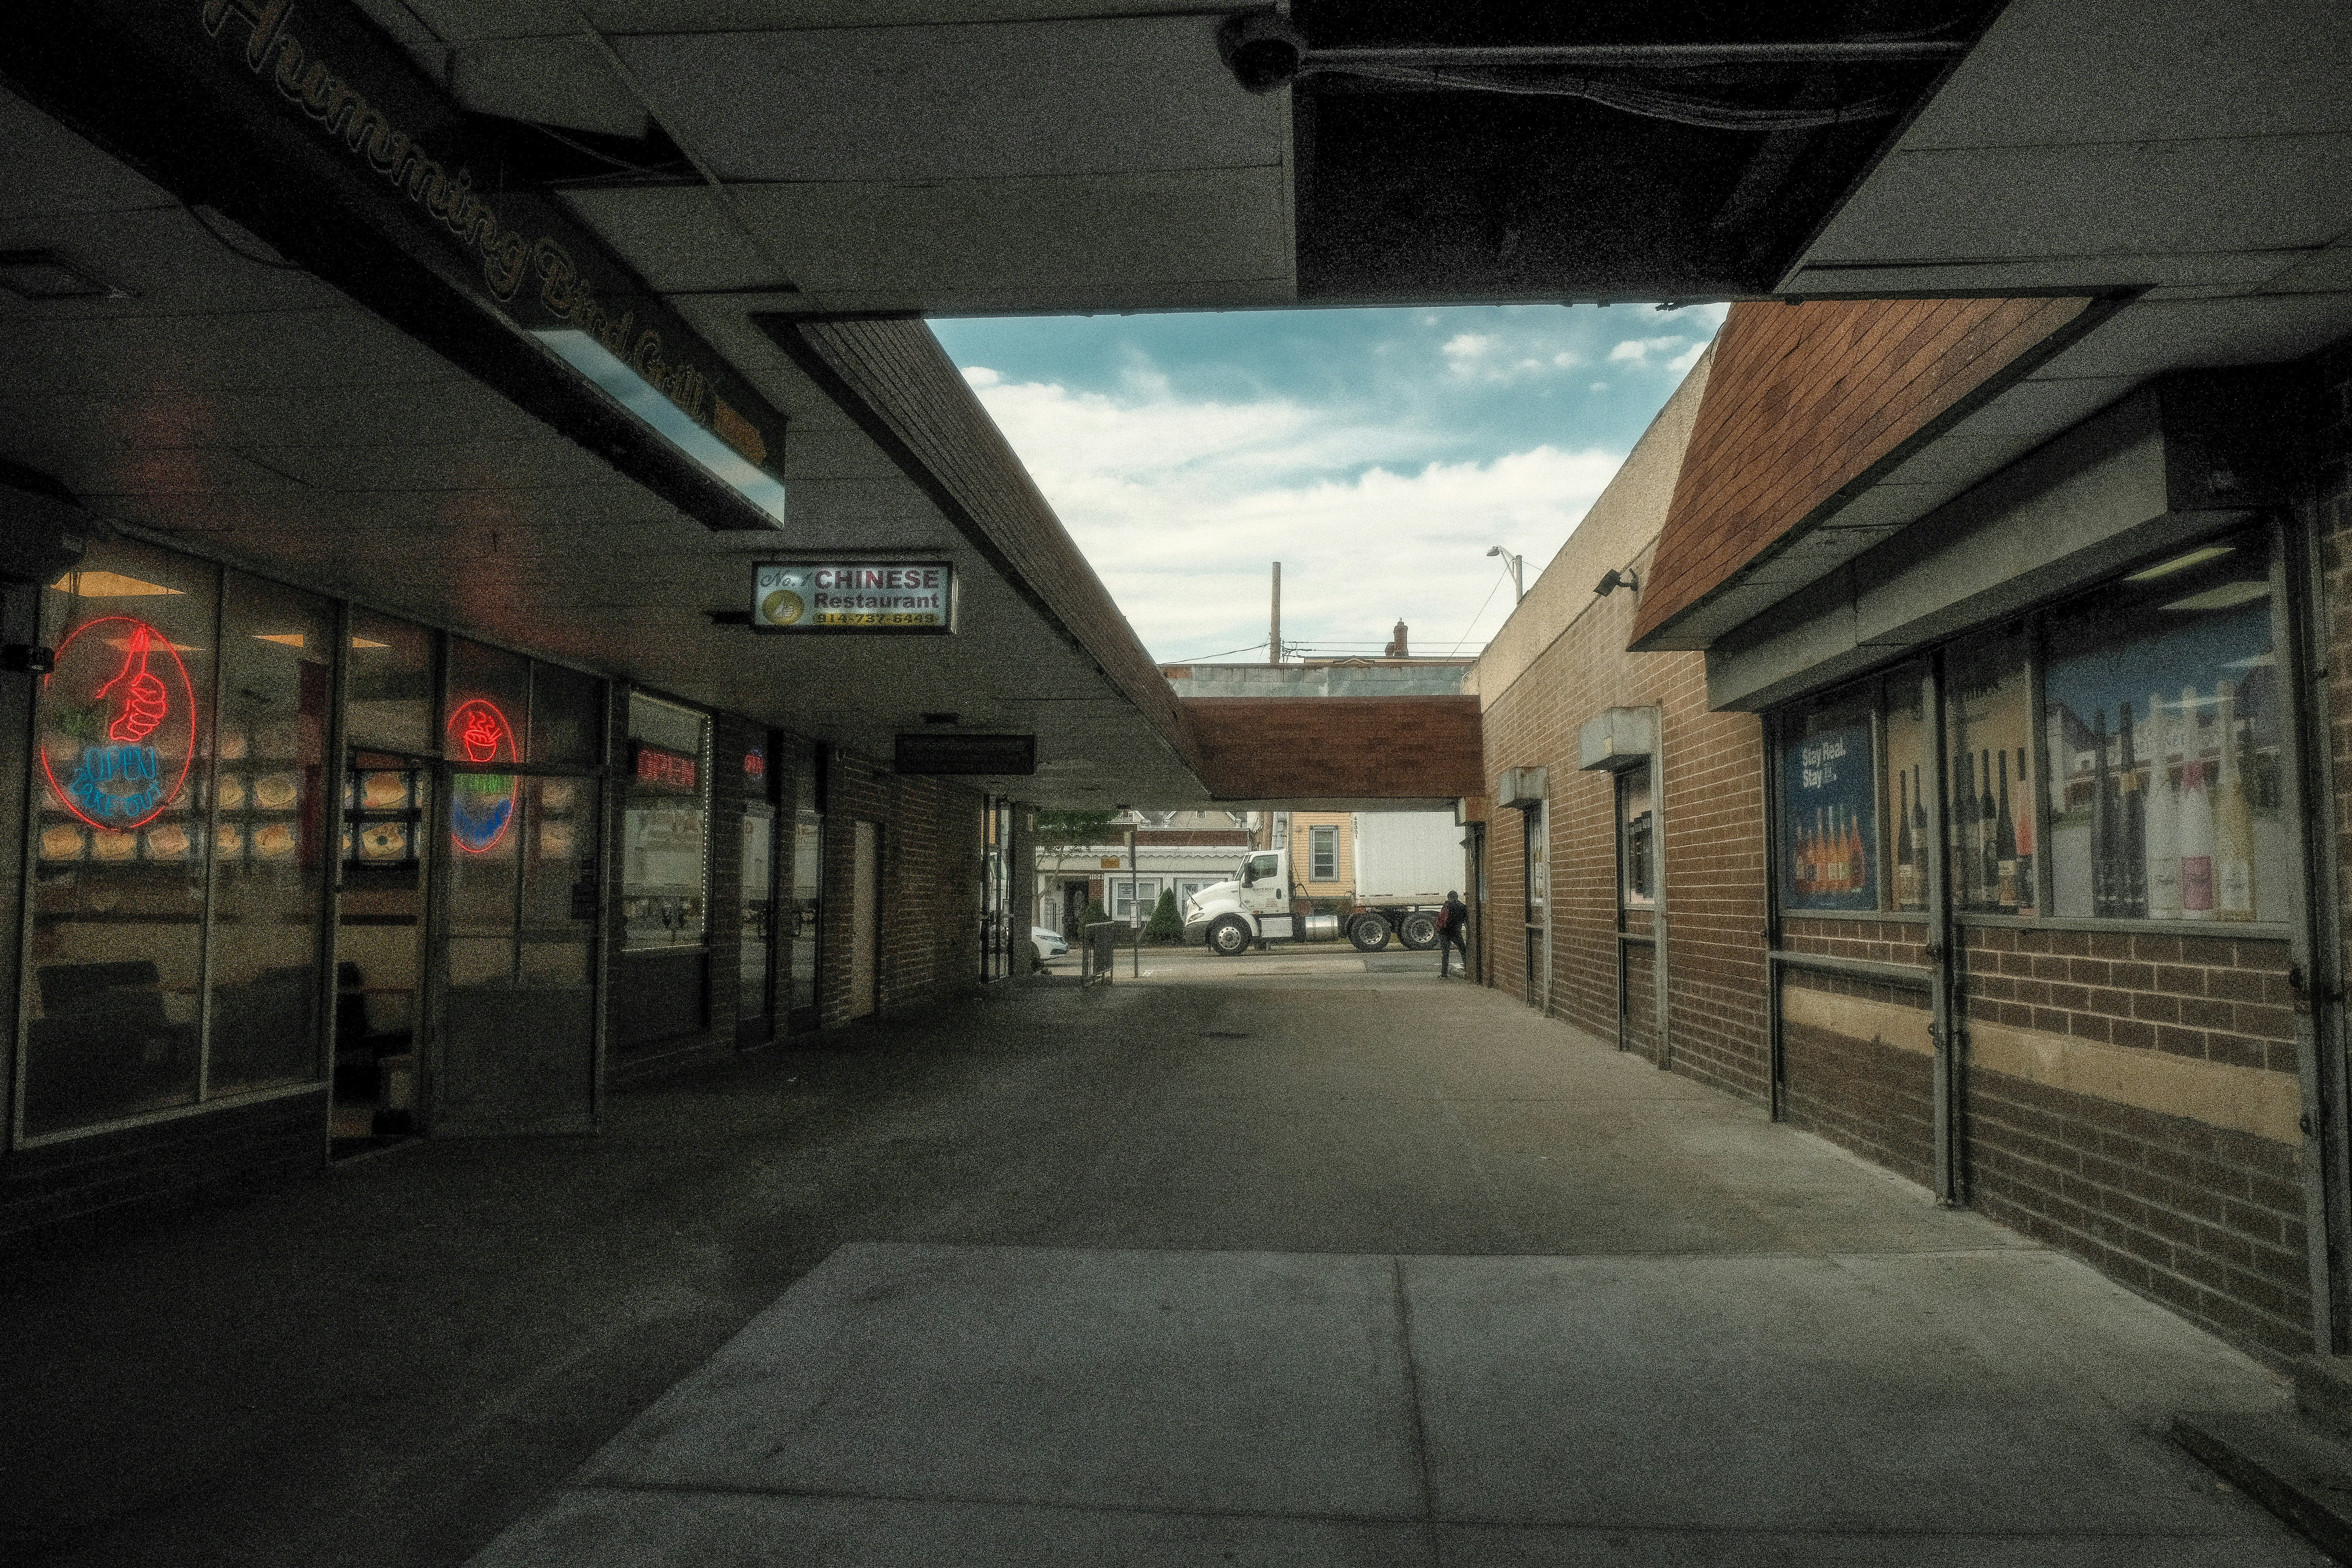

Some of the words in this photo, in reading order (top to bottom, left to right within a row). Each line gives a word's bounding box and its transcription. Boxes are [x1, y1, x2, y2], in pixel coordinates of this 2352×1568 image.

[815, 570, 939, 589] CHINESE
[814, 593, 939, 609] Restaurant
[86, 746, 156, 782] OPEN
[1802, 748, 1822, 767] Stay
[1803, 769, 1822, 789] Stay
[126, 780, 161, 816] OUT
